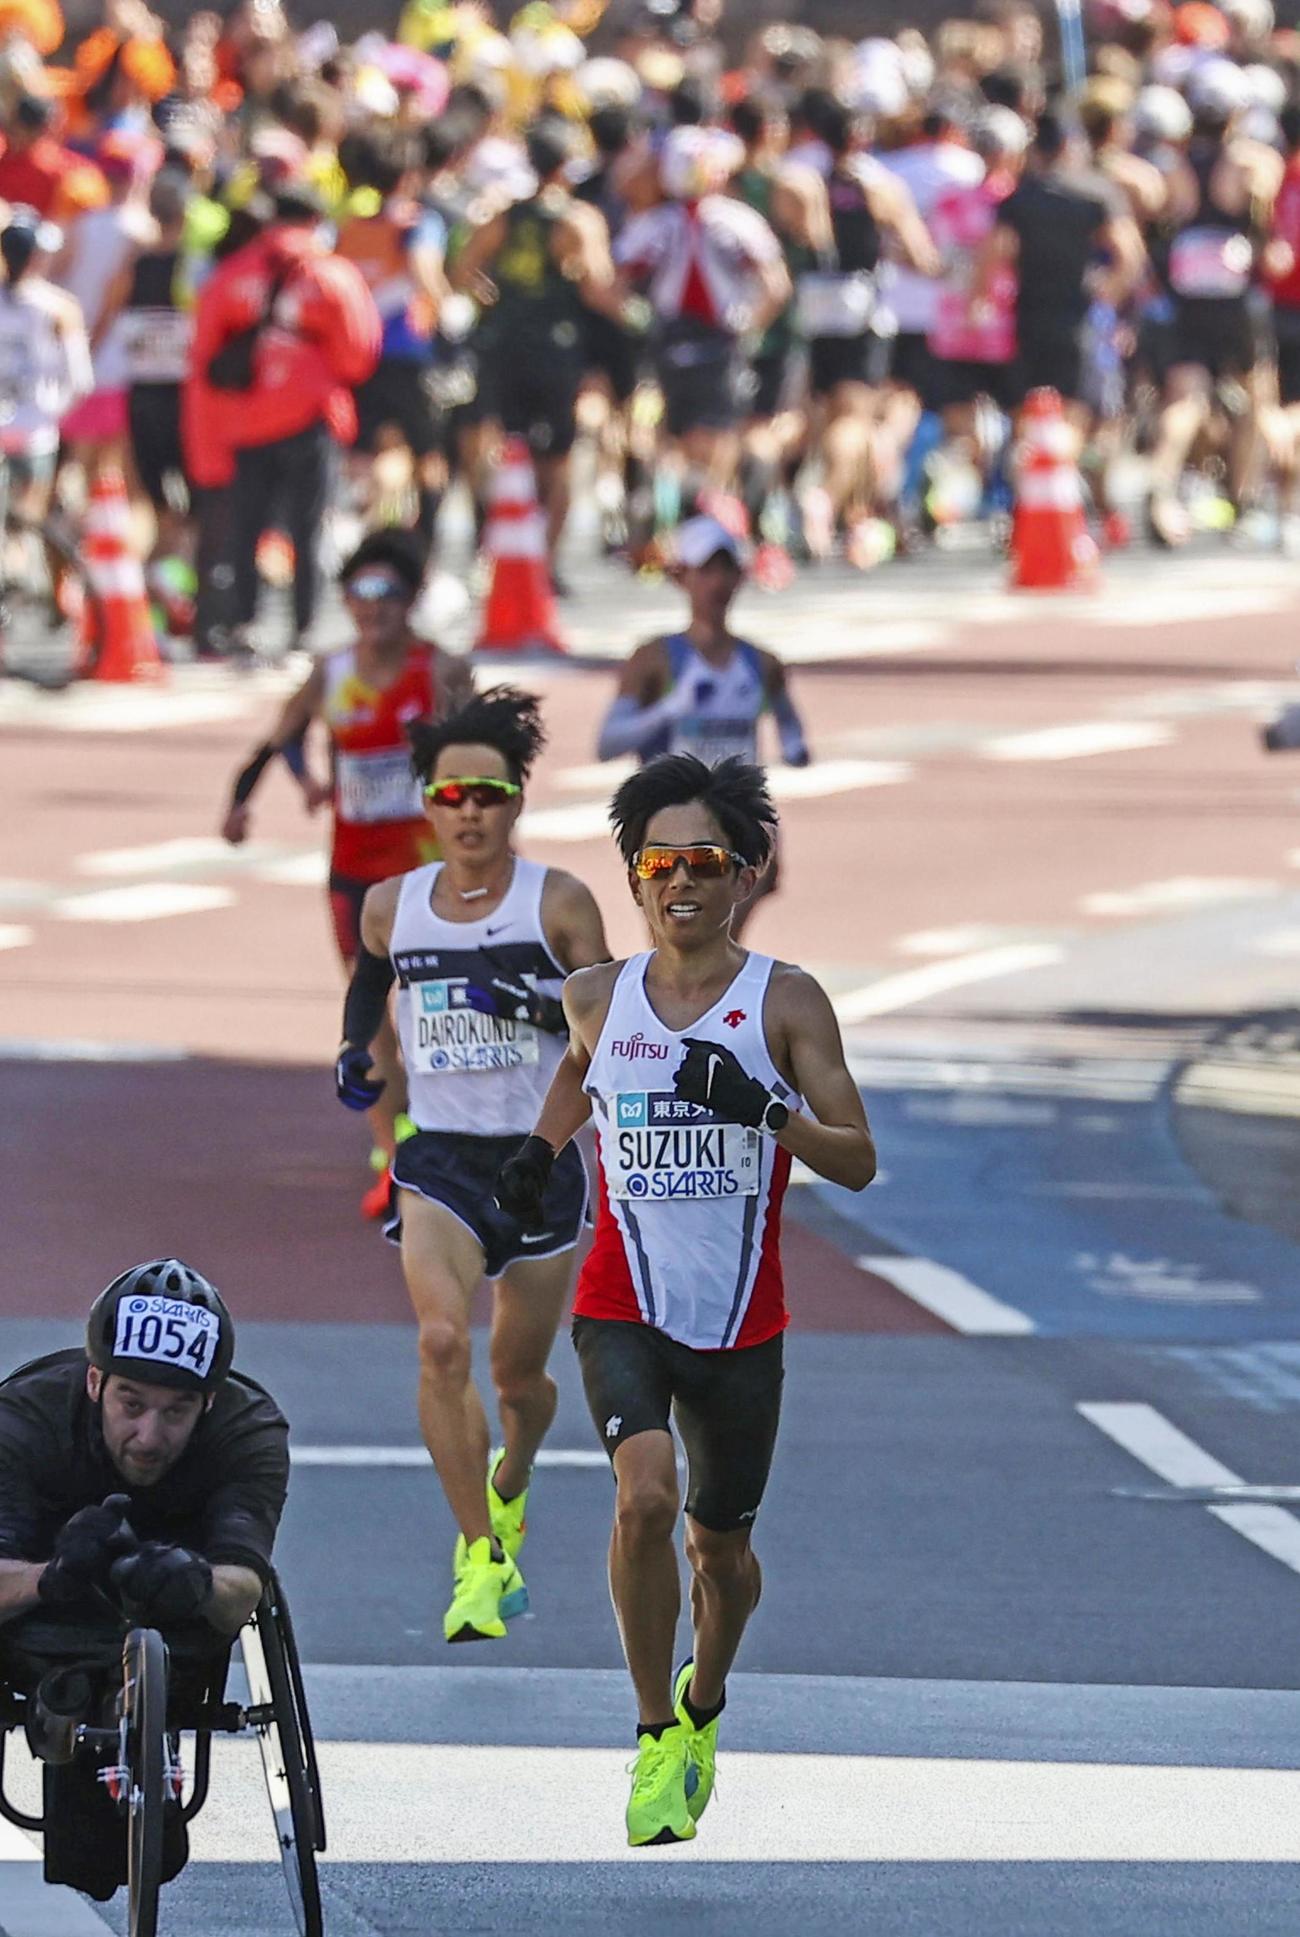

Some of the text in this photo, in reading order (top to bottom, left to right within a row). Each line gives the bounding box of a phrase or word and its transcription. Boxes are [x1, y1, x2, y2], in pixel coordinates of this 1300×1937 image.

[611, 1033, 669, 1061] FUJITSU
[619, 1128, 725, 1171] SUZUKI
[122, 1315, 209, 1369] 1054
